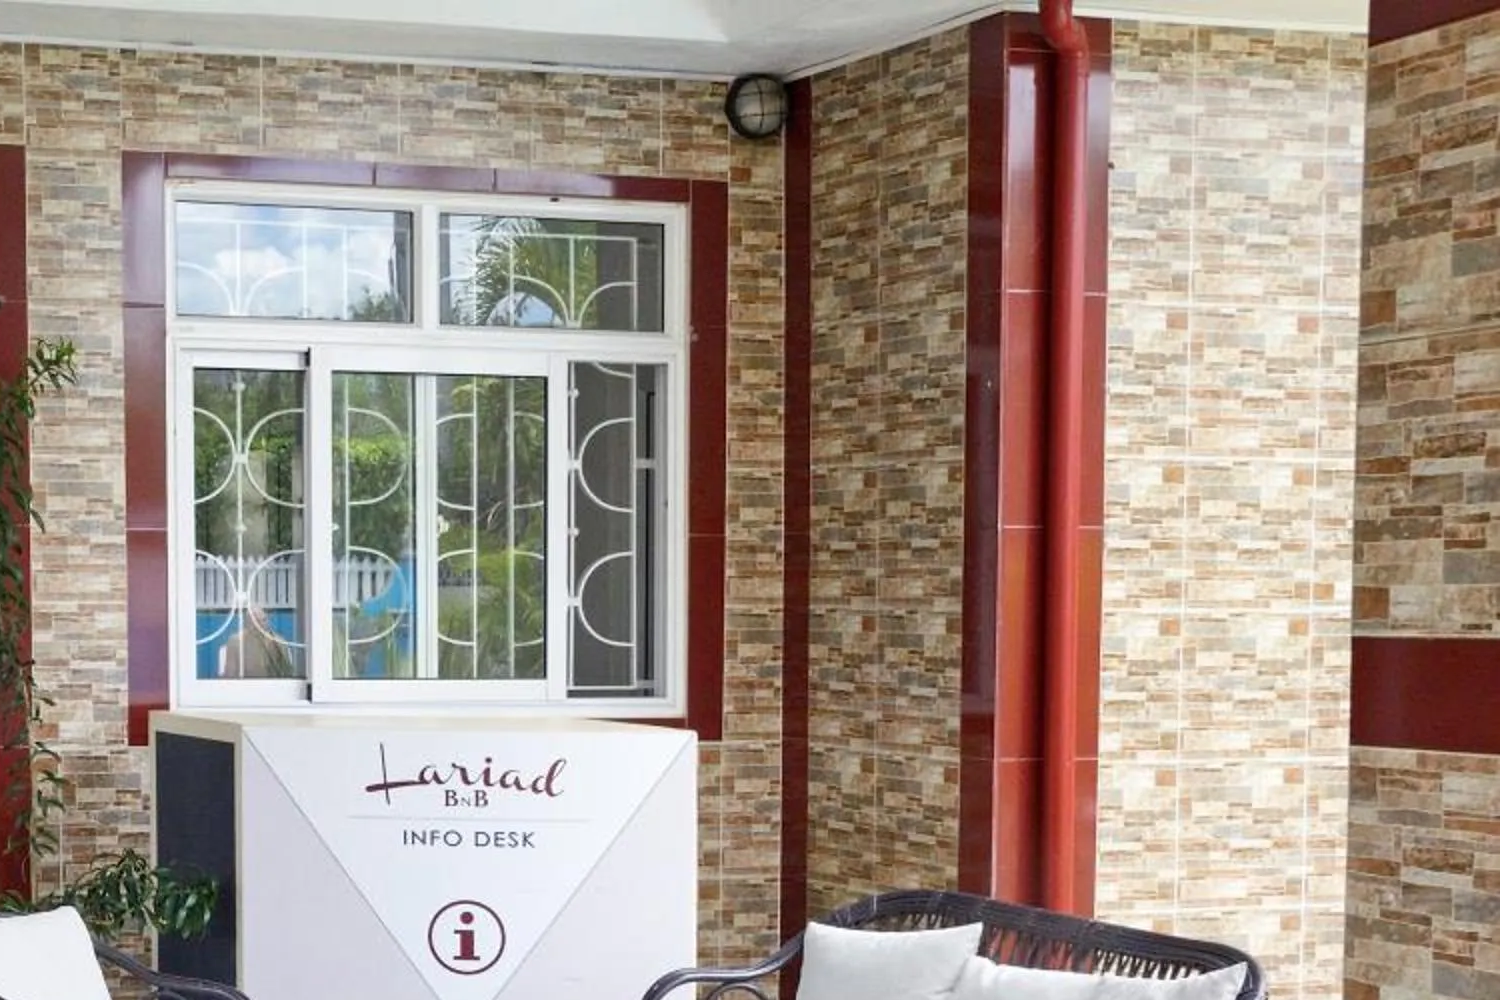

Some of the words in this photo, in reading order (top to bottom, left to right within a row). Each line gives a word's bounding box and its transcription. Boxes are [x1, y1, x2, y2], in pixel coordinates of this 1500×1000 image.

[365, 741, 568, 806] Lariad
[402, 828, 464, 848] INFO
[474, 830, 537, 850] DESK
